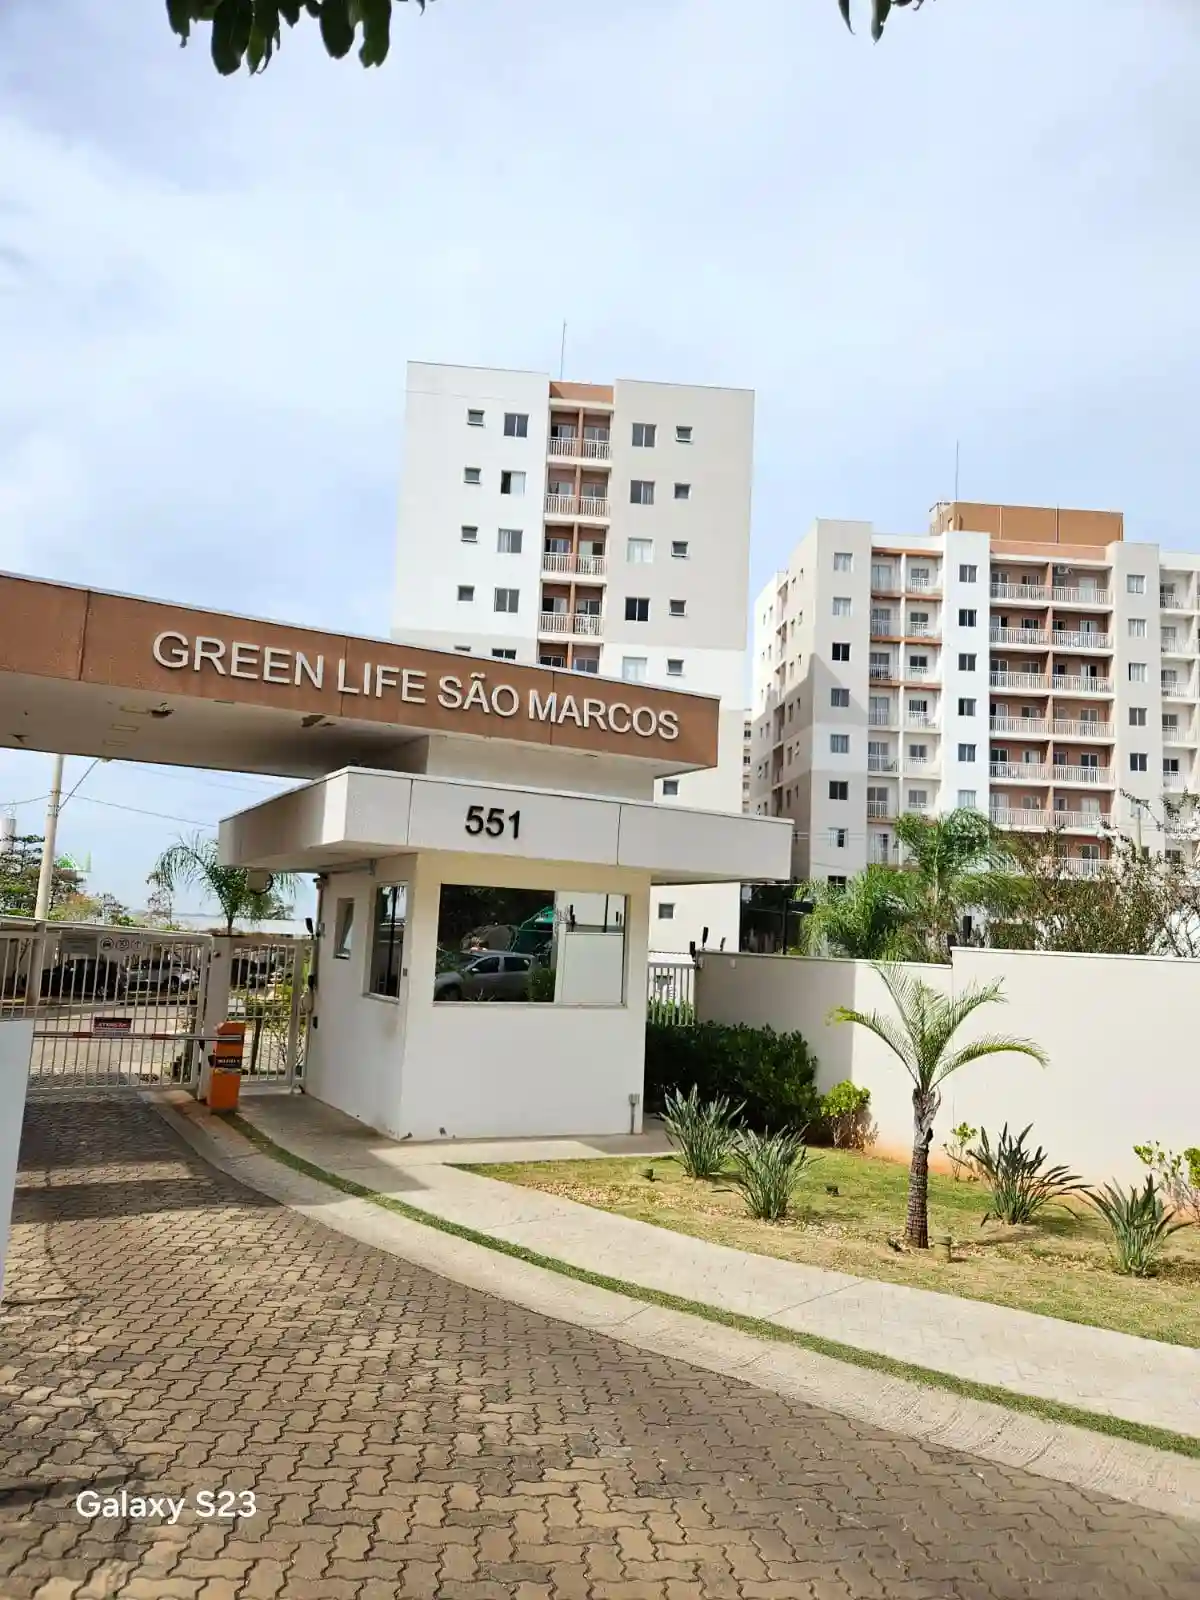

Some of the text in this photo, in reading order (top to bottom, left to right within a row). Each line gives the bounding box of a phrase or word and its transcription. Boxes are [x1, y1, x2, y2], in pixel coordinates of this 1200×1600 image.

[153, 631, 680, 740] GREEN LIFE SÃO MARCOS
[465, 805, 521, 839] 551
